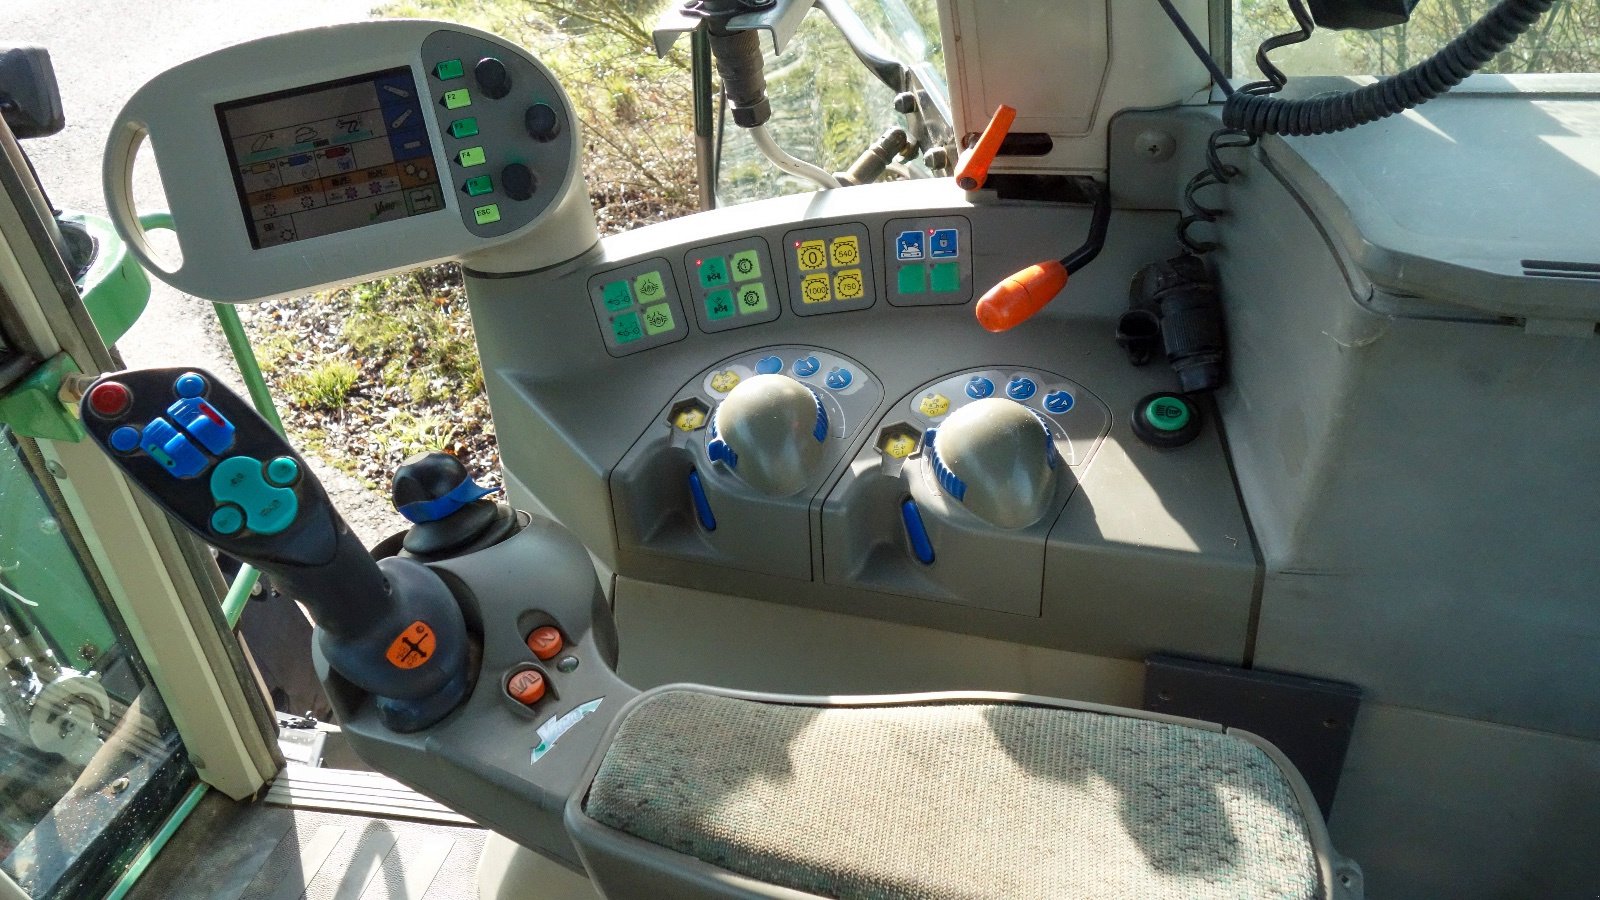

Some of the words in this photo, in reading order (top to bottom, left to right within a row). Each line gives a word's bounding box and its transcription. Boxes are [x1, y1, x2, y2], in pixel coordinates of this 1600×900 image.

[476, 208, 491, 216] ESC
[808, 251, 818, 264] 0
[838, 250, 852, 258] 540
[809, 286, 826, 295] 1000
[843, 283, 856, 291] 750
